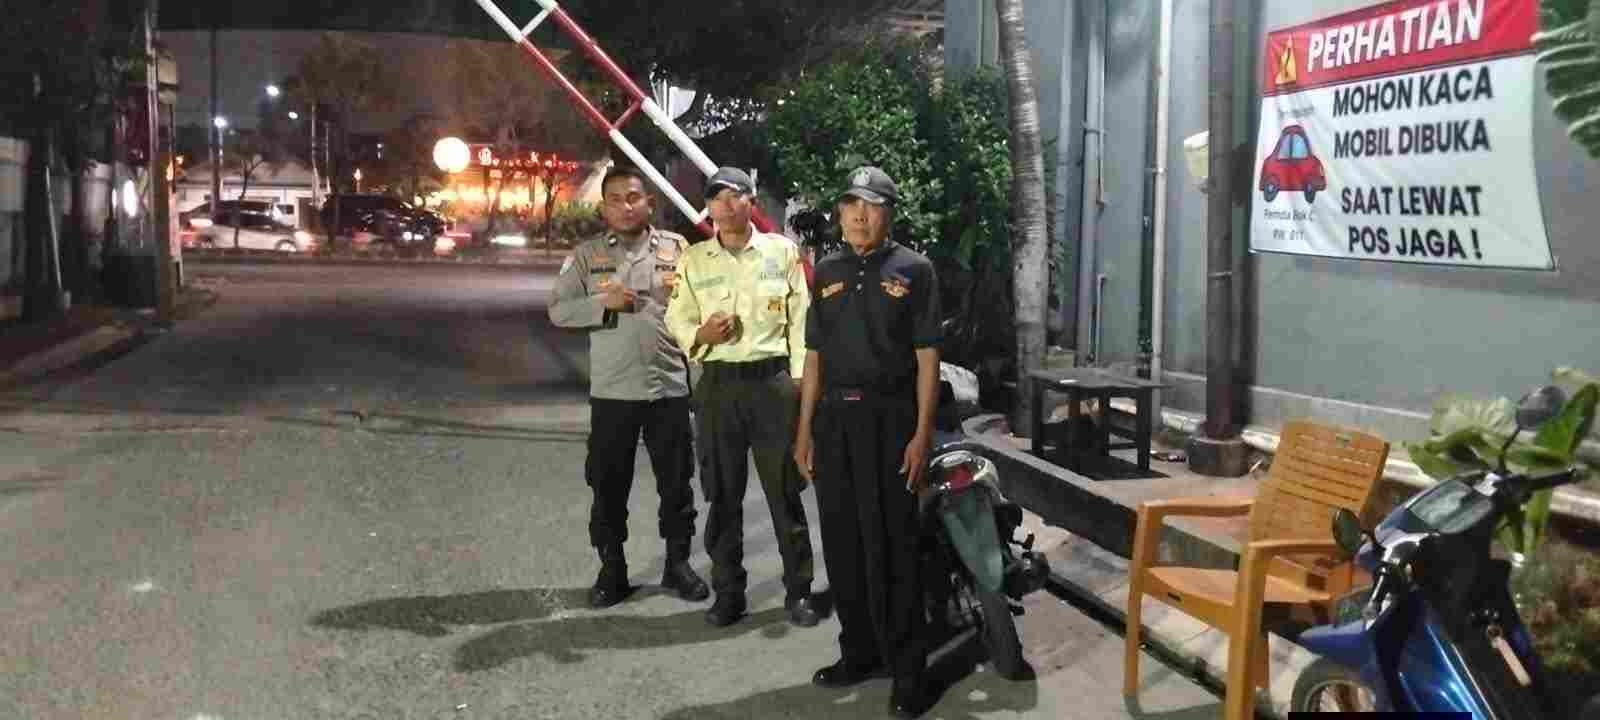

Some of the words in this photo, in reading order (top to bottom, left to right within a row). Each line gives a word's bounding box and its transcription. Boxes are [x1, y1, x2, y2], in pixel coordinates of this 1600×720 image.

[1308, 0, 1485, 72] PERHATIAN
[1333, 79, 1412, 117] MOHON
[1419, 66, 1493, 107] KACA
[1334, 128, 1393, 158] MOBIL
[1399, 118, 1490, 155] DIBUKA
[1341, 187, 1393, 215] SAAT
[1399, 186, 1482, 216] LEWAT
[1349, 225, 1390, 255] POS
[1396, 227, 1467, 259] JAGA
